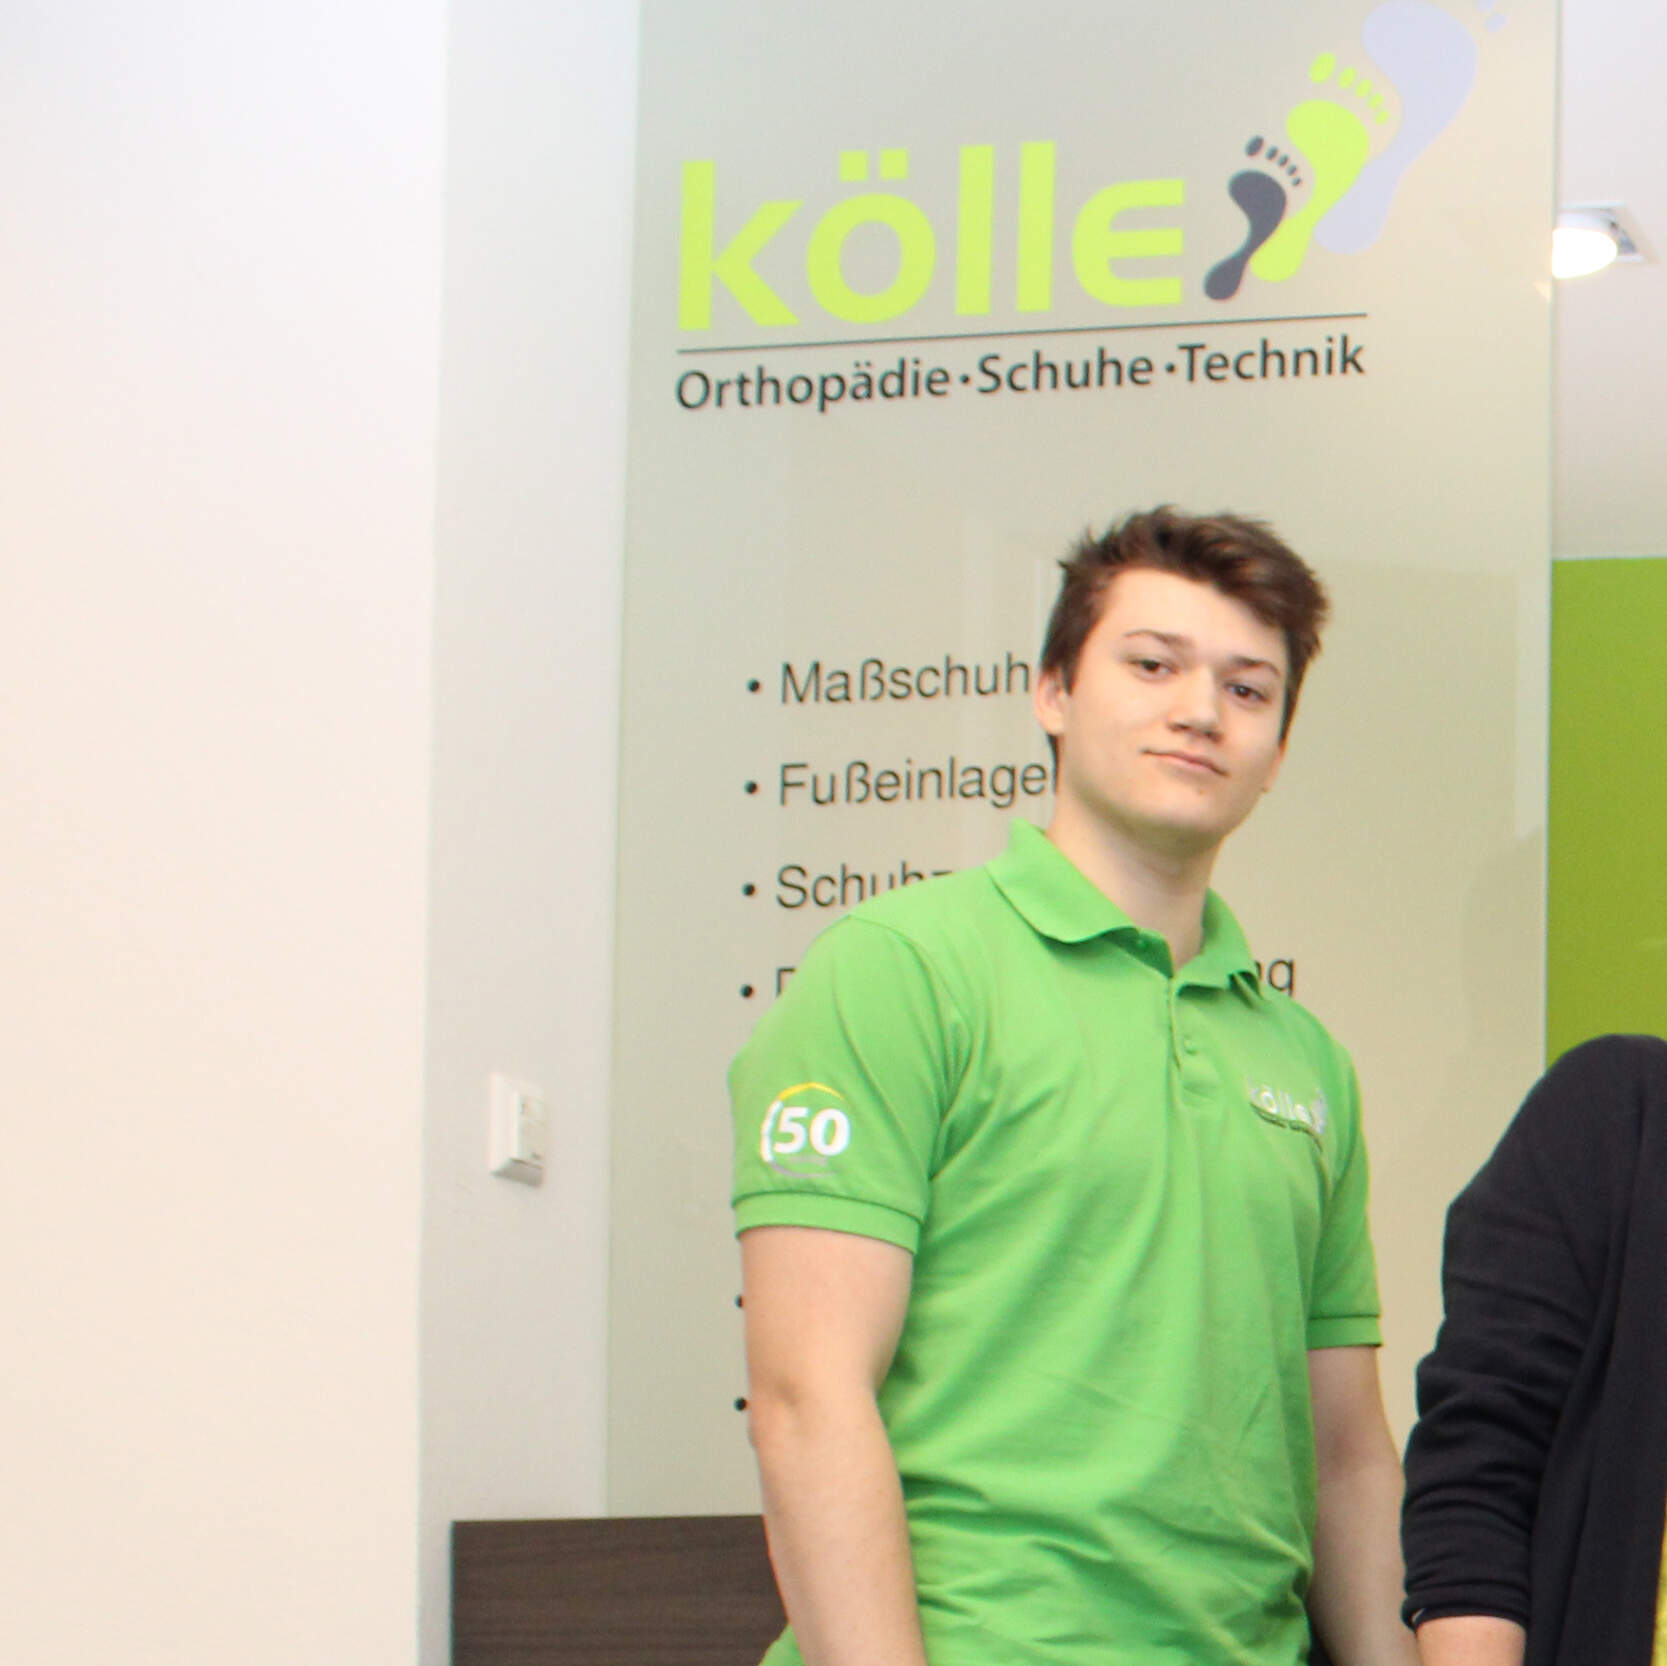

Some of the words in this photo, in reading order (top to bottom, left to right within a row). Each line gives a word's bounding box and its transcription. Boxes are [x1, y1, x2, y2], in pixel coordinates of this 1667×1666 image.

[678, 141, 1185, 331] kölle
[676, 358, 949, 413] Orthopädie
[976, 349, 1153, 394] Schuhe
[1177, 334, 1365, 384] Technik
[781, 651, 1030, 704] Maßschuh
[776, 860, 953, 909] Schuh
[774, 1106, 851, 1157] 50
